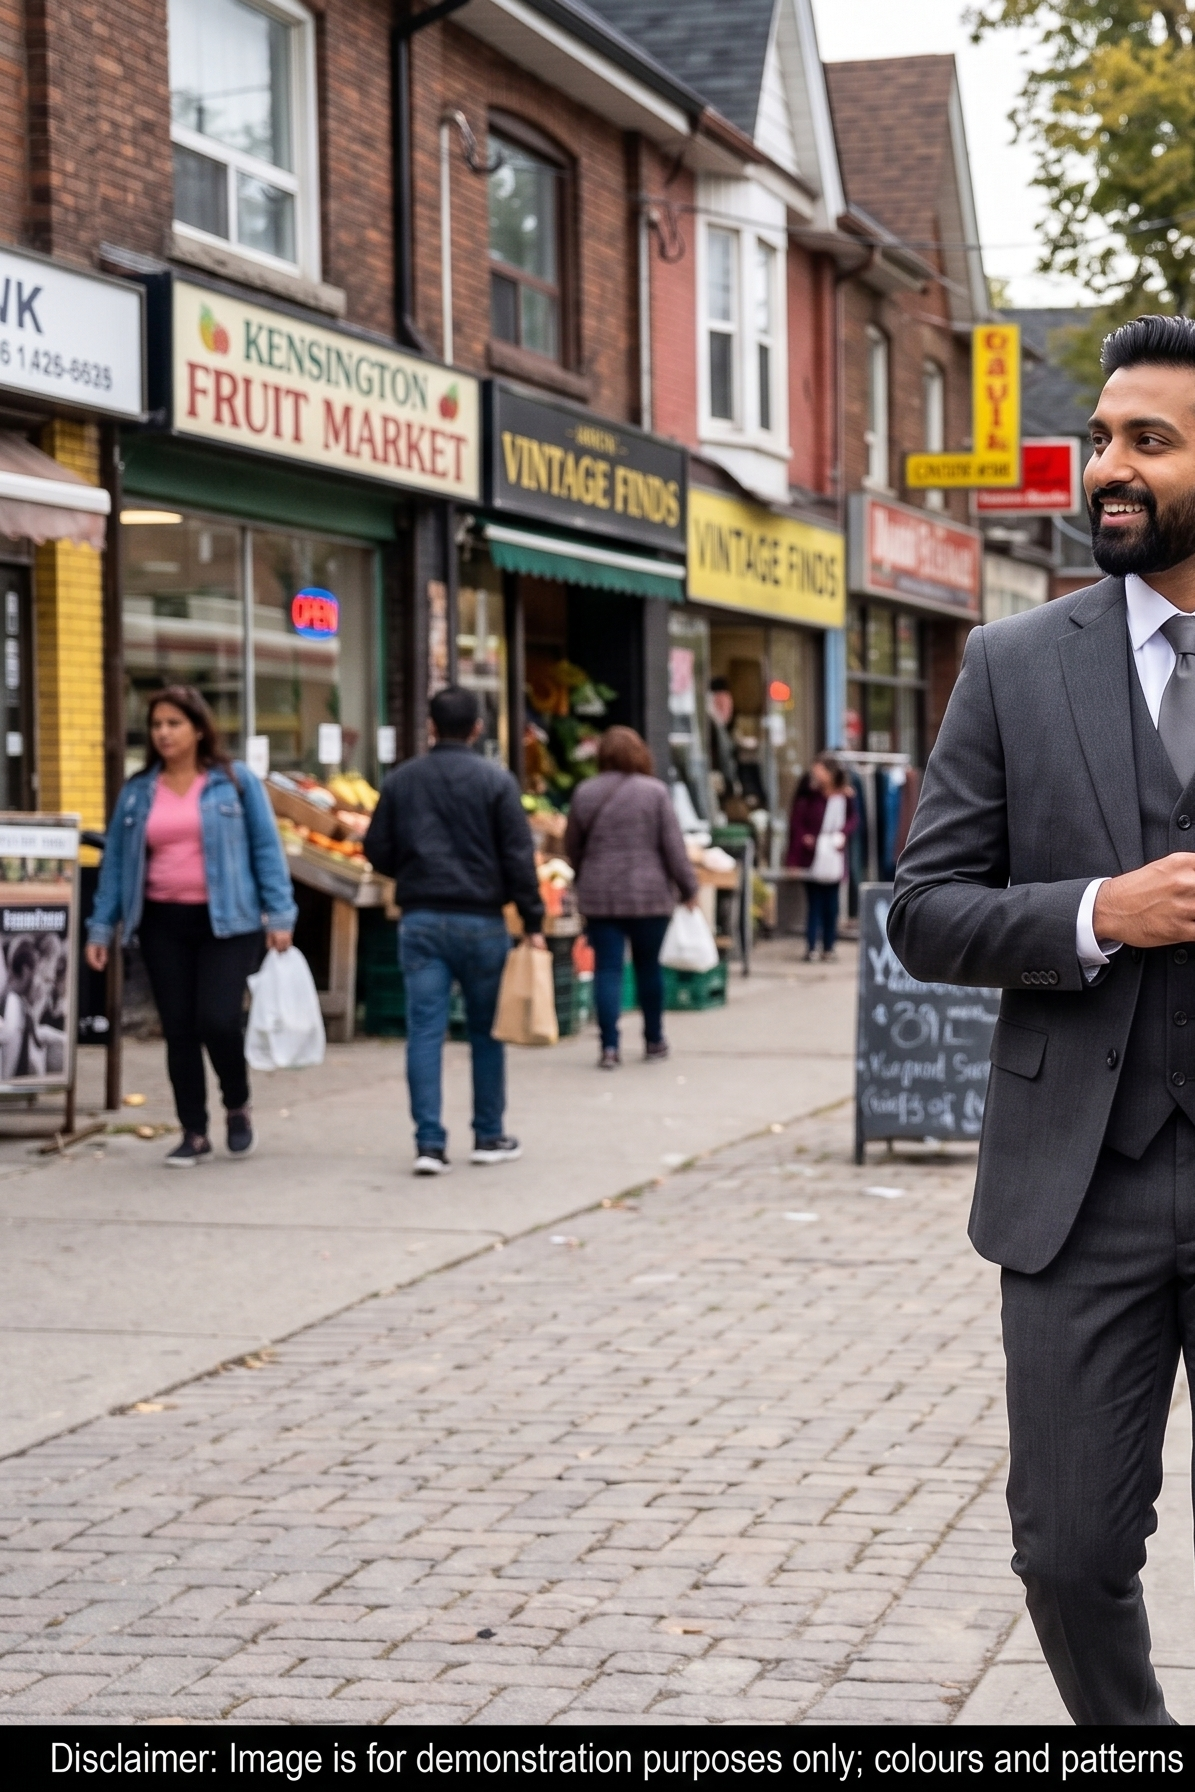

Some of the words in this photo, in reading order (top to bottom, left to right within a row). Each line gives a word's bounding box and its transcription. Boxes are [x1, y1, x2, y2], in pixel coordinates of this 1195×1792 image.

[243, 317, 429, 412] KENSINGTON
[185, 360, 309, 445] FRUIT
[322, 397, 469, 484] MARKET
[502, 430, 612, 510] VINTAGE
[614, 464, 682, 529] FINDS
[693, 517, 781, 589] VINTAGE
[786, 541, 838, 600] FINDS
